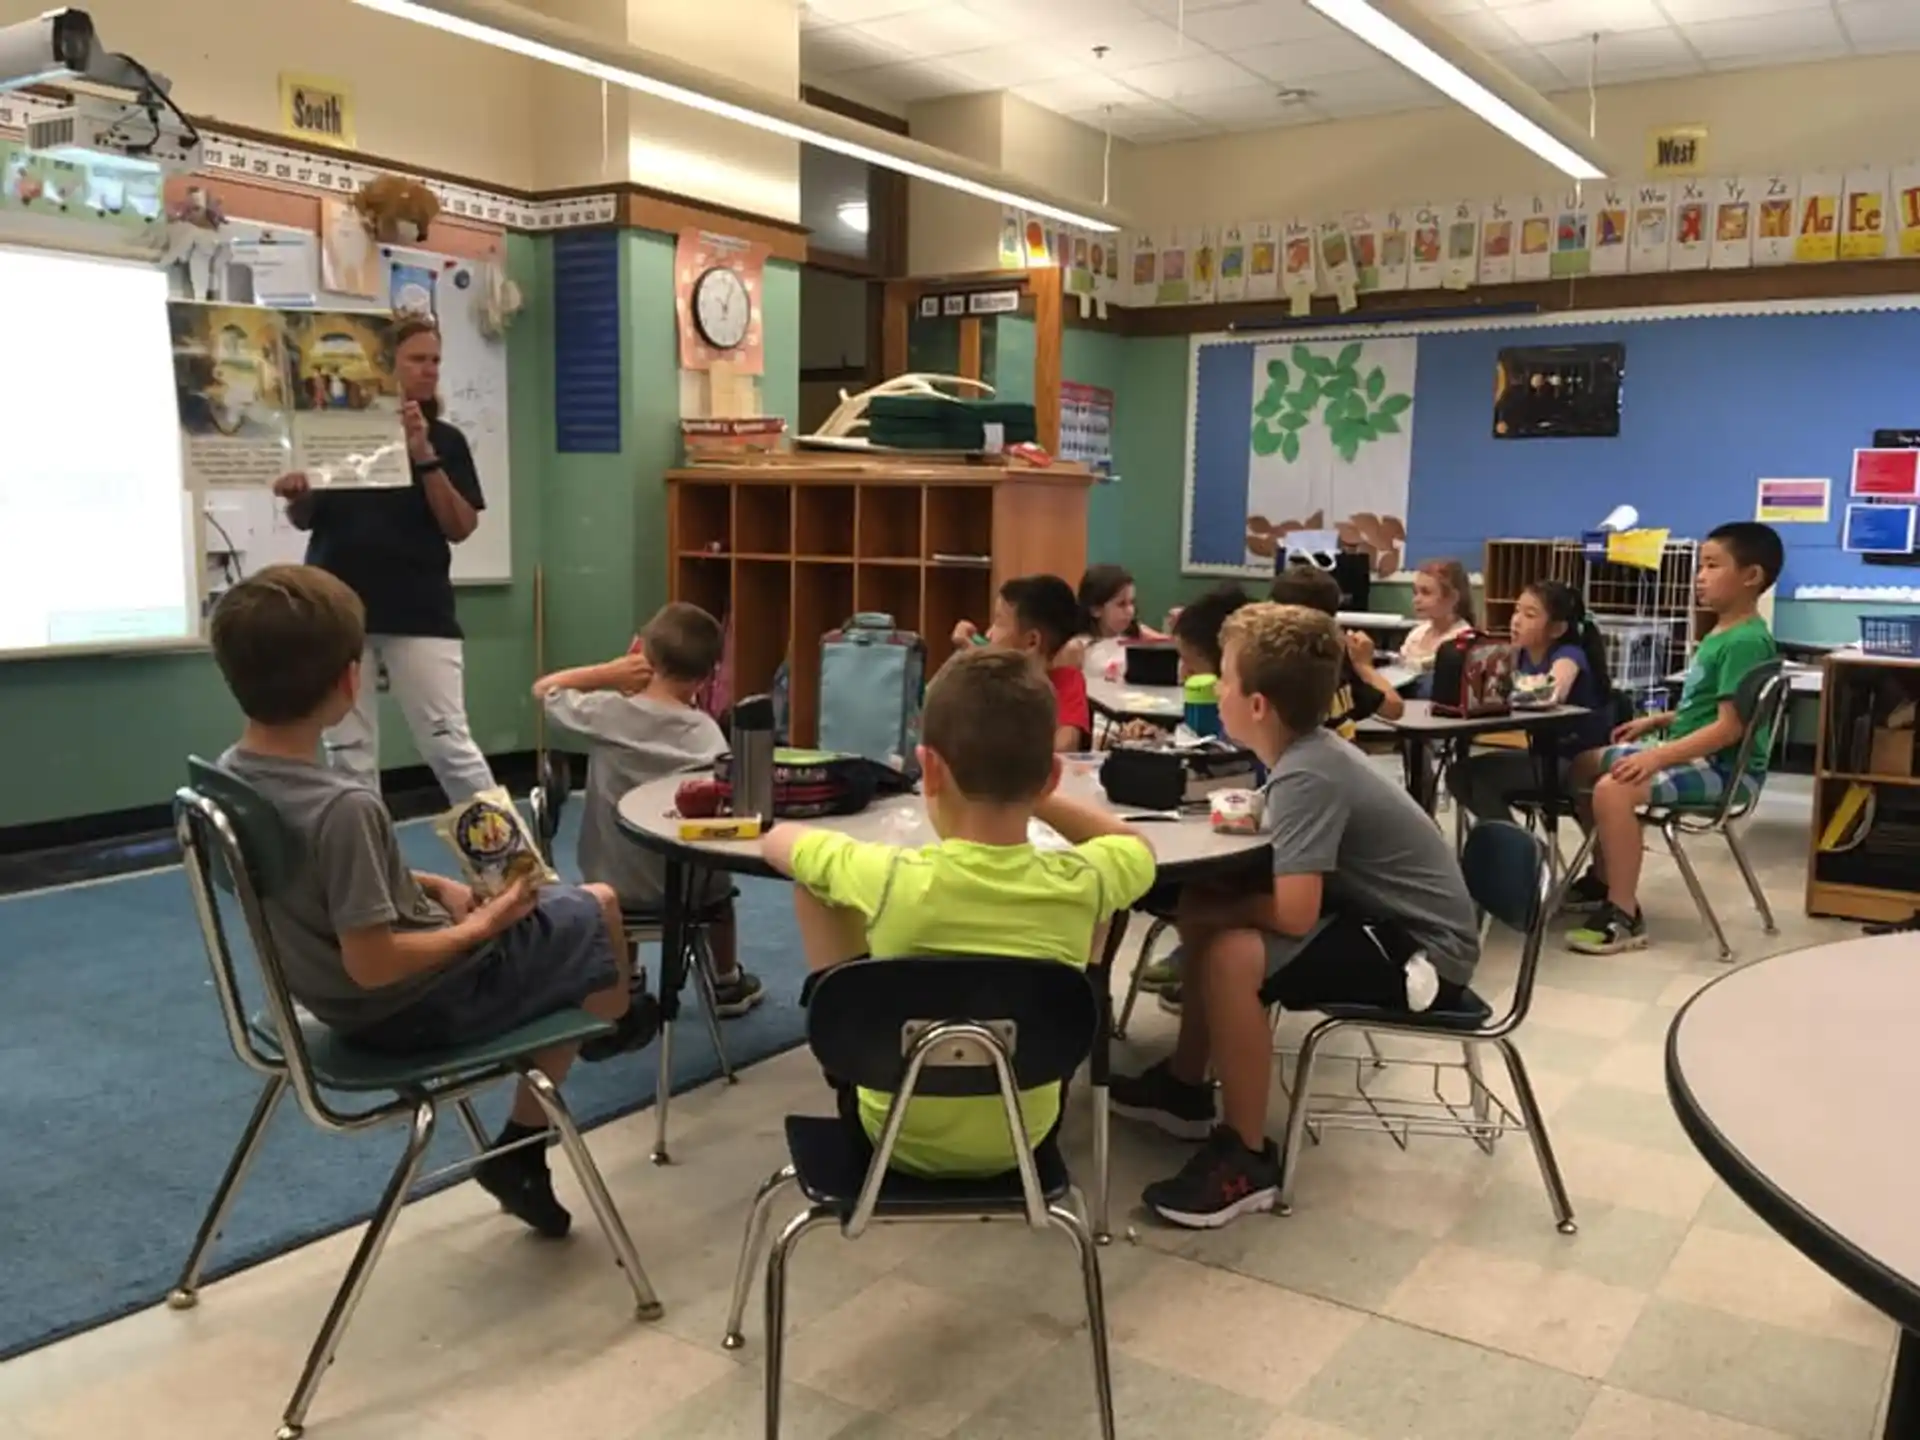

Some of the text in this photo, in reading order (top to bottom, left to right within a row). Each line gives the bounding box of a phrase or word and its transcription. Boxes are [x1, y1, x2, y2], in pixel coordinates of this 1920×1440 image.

[292, 88, 342, 136] South
[1657, 137, 1696, 167] West
[1801, 195, 1834, 235] Aa
[1848, 192, 1882, 233] Ee
